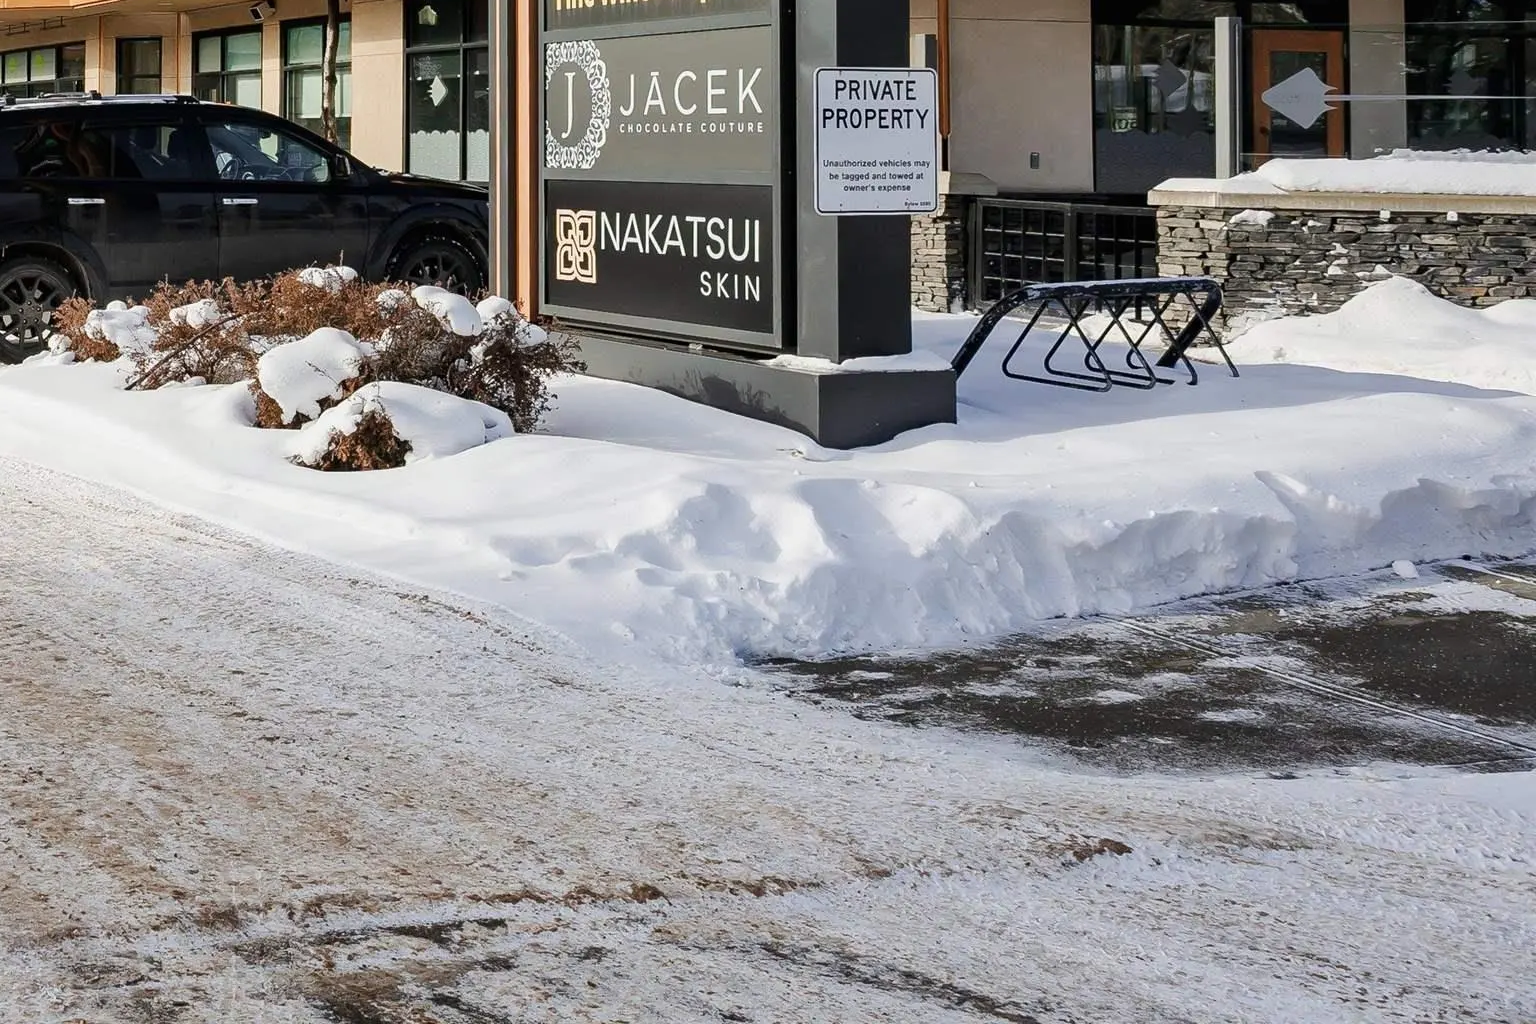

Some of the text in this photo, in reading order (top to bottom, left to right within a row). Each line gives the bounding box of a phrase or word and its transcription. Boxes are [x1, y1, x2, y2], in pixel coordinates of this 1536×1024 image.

[834, 79, 917, 101] PRIVATE
[822, 108, 930, 129] PROPERTY
[619, 122, 764, 134] CHOCOLATE COUTURE
[823, 159, 931, 169] Unauthorized vehicles may
[829, 172, 924, 182] be tagged and towed at
[843, 184, 912, 193] owner's expense
[600, 211, 760, 263] NAKATSUI
[699, 271, 761, 302] SKIN
